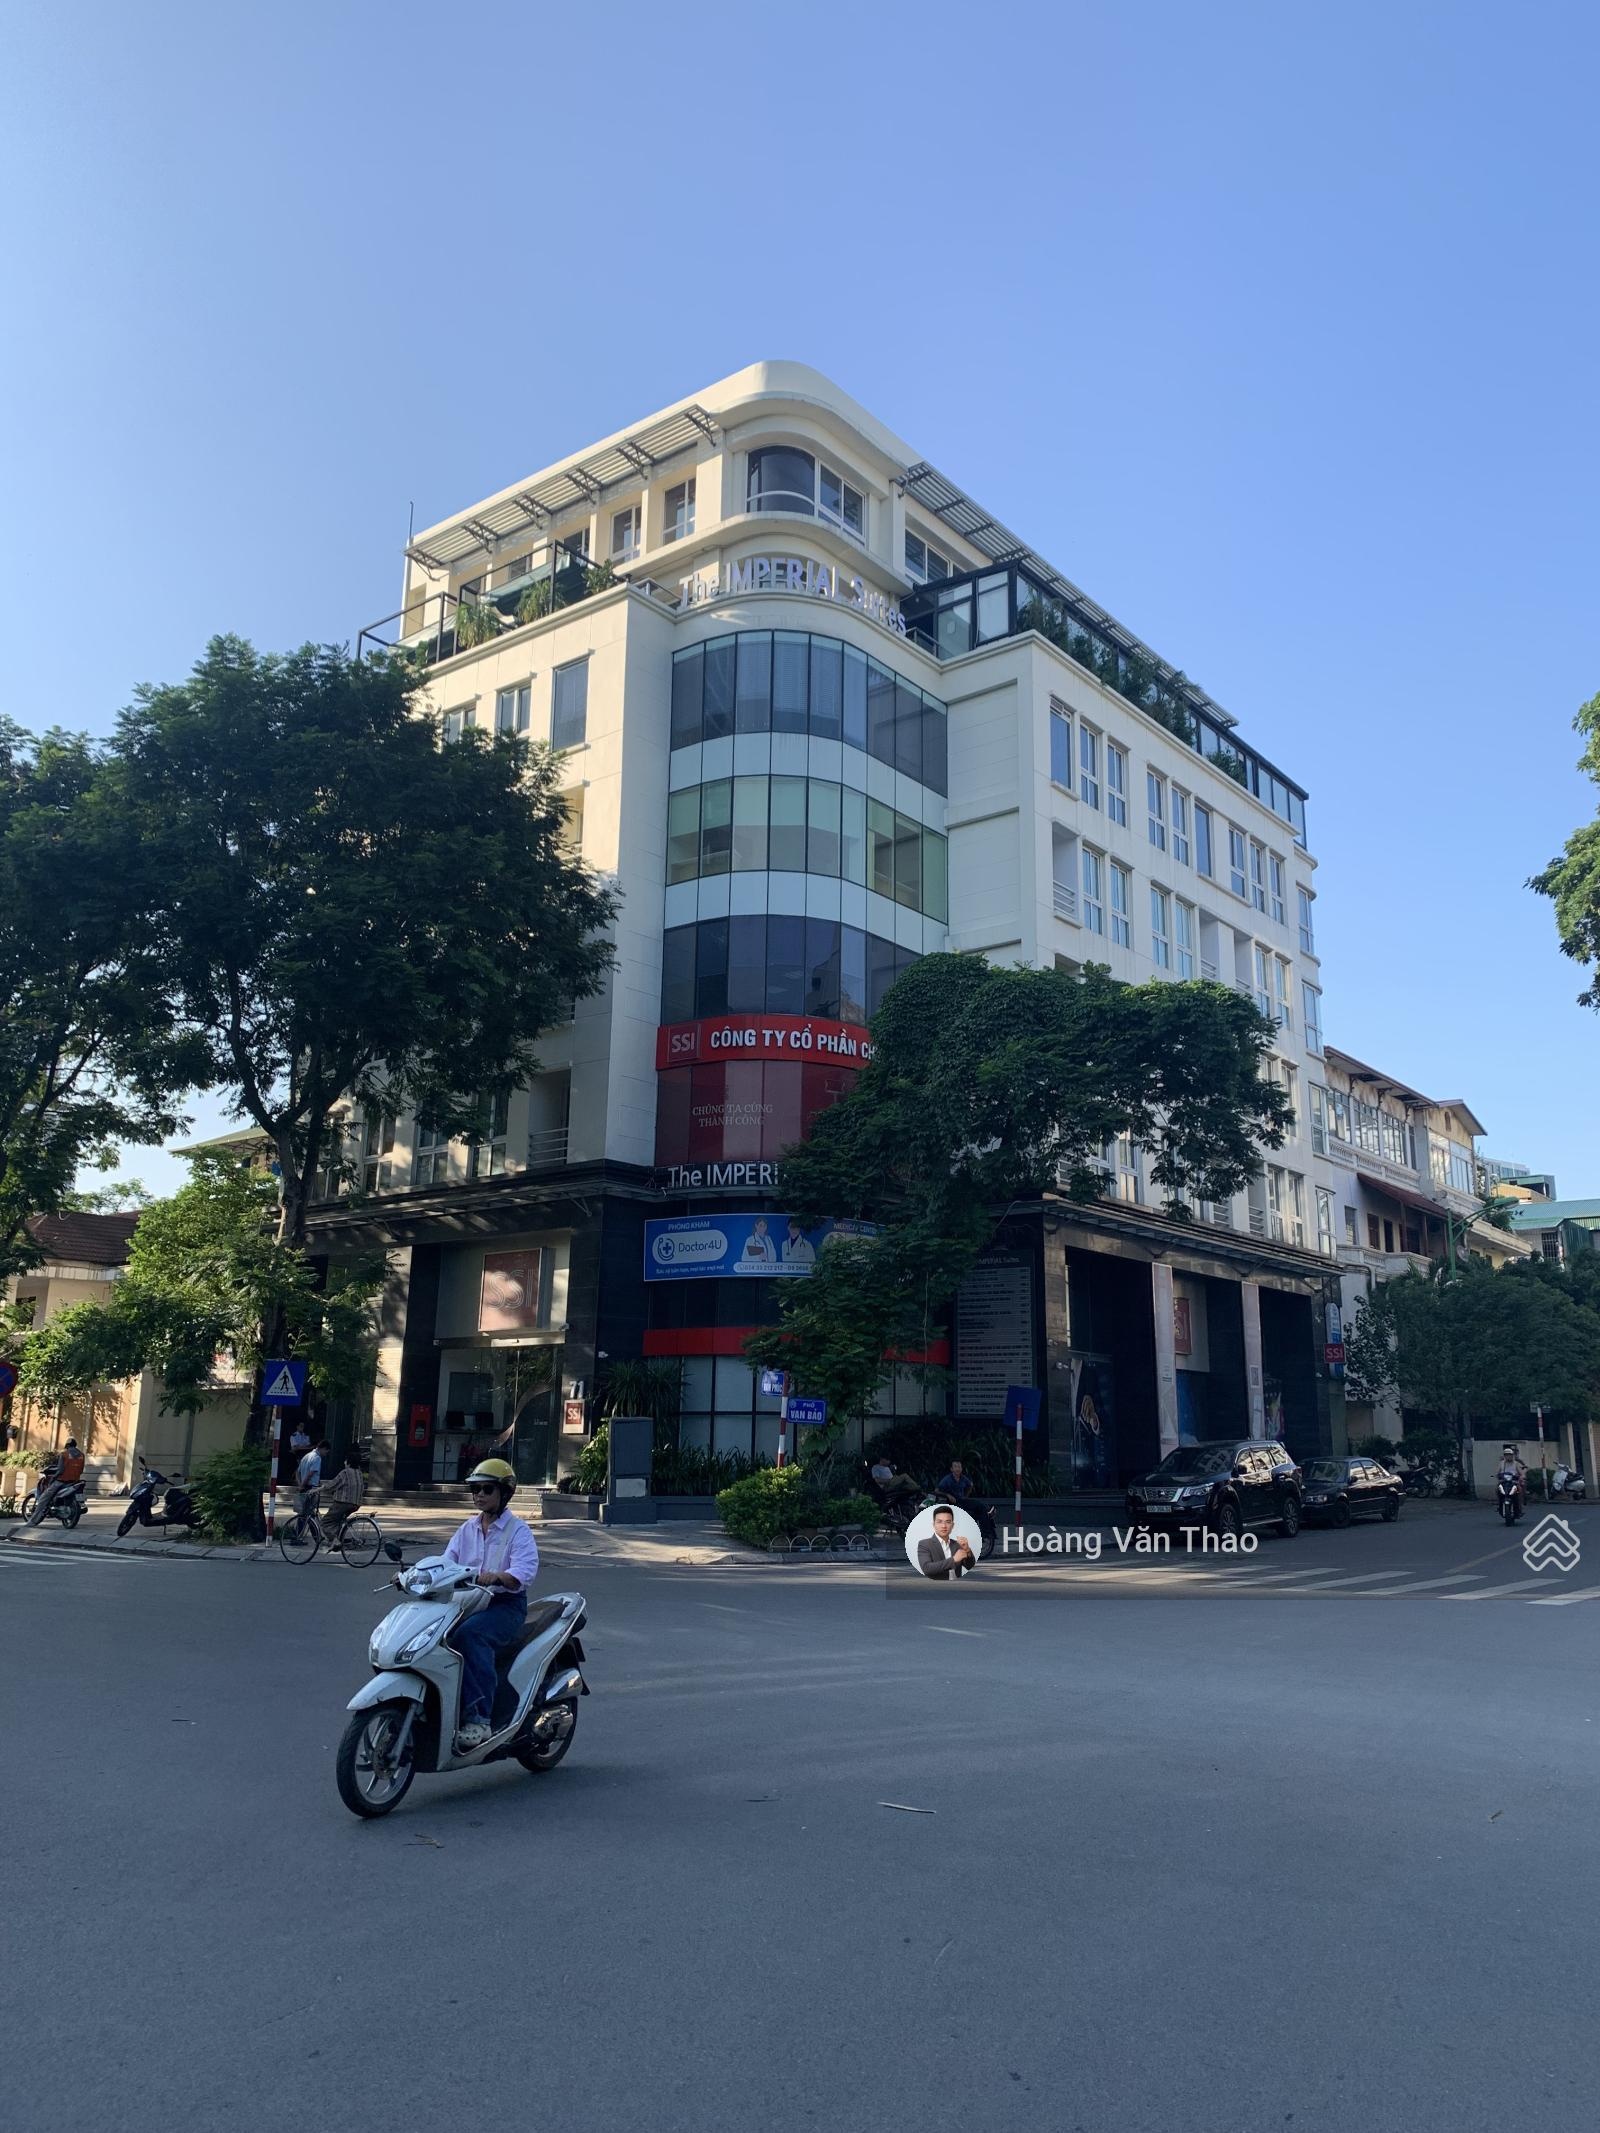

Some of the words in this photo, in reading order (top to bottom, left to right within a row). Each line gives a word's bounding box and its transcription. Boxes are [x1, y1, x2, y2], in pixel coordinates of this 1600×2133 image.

[678, 571, 720, 609] The
[671, 1032, 695, 1053] SSI
[710, 1026, 756, 1049] CÔNG
[762, 1029, 787, 1047] TY
[790, 1023, 812, 1050] CỔ
[817, 1028, 857, 1056] PHẦN
[668, 1165, 702, 1188] The
[678, 1239, 722, 1252] Doctor4U
[1326, 1348, 1343, 1359] SSI
[569, 1380, 584, 1398] 71
[567, 1407, 581, 1420] SSI
